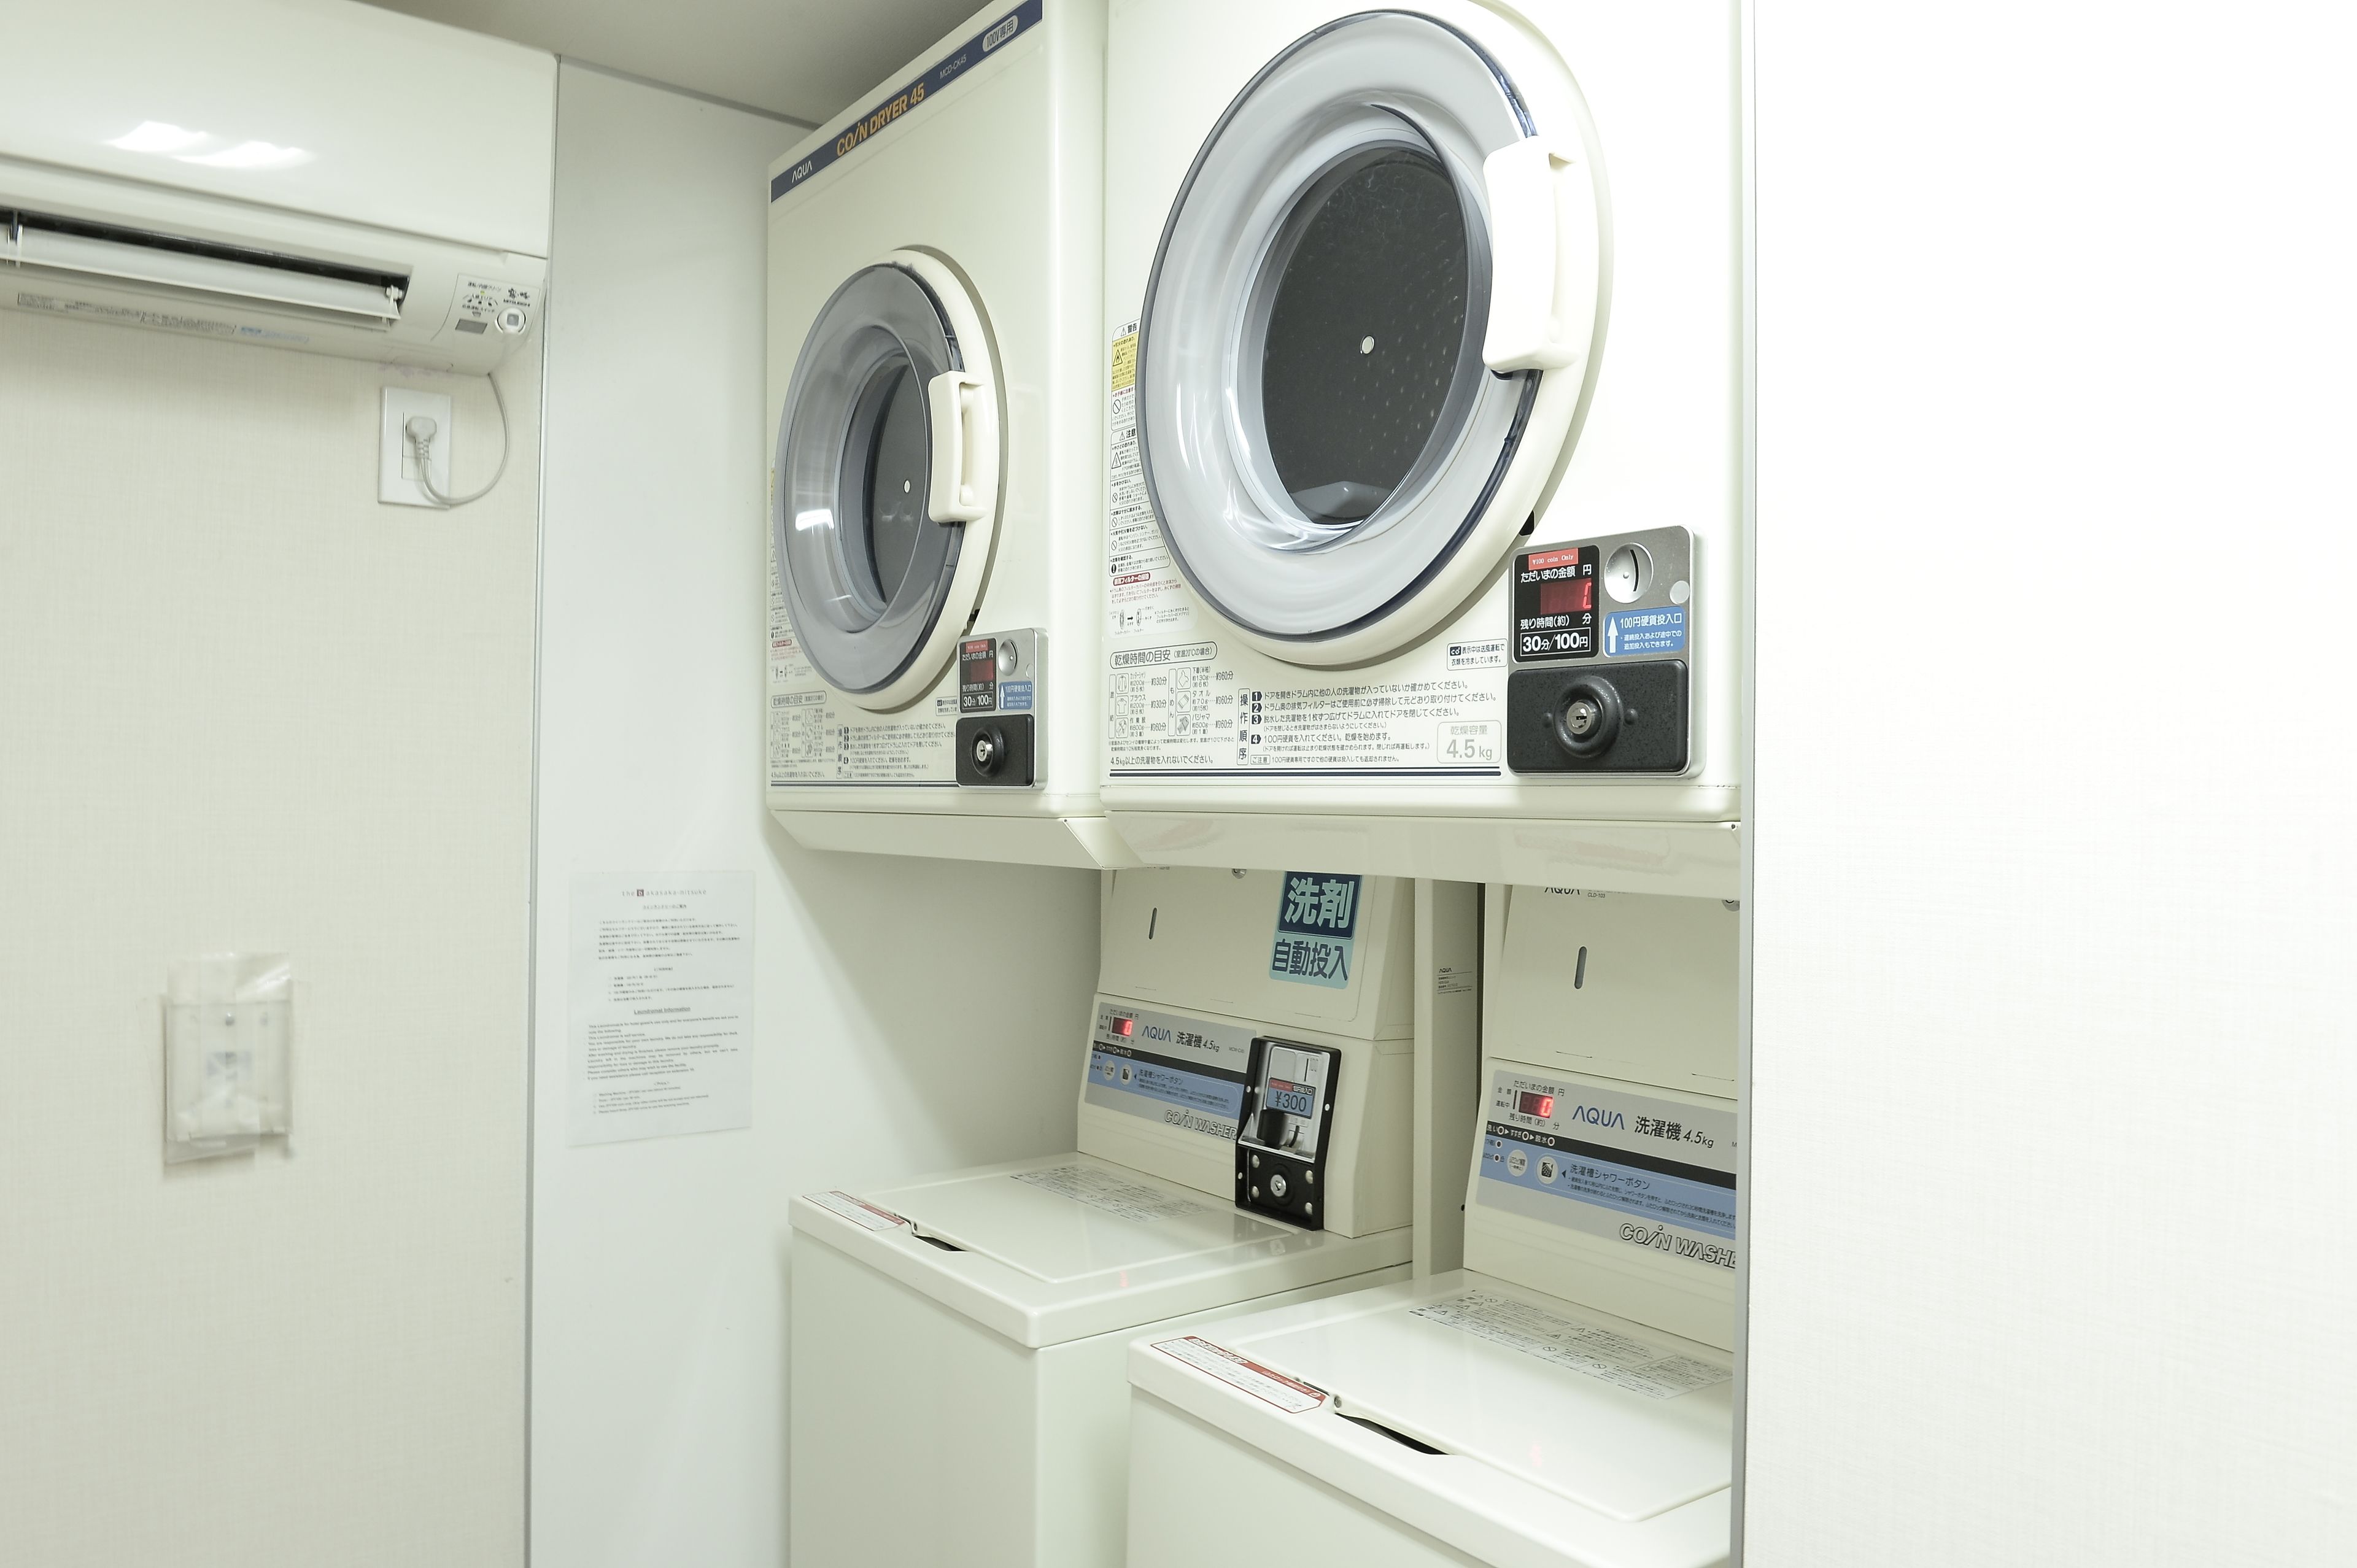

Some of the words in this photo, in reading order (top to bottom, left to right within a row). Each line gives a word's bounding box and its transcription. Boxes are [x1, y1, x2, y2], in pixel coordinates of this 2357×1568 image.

[986, 19, 1014, 48] 100V専用
[940, 54, 967, 79] MCD-CK45
[792, 160, 813, 183] AQUA
[870, 95, 908, 135] DRYER
[910, 82, 925, 105] 45
[1562, 553, 1574, 562] Only
[1520, 565, 1576, 584] ただいまの金額
[1582, 564, 1593, 576] 円
[1520, 616, 1570, 629] 残り時間(約)
[1582, 613, 1592, 625] 分
[1522, 632, 1589, 652] 30分/100円
[1114, 649, 1171, 666] 乾燥時間の目安
[1450, 725, 1488, 736] 乾燥容量
[1447, 739, 1475, 759] 4.5
[1479, 746, 1493, 761] kg
[1284, 877, 1355, 929] 洗剤
[1271, 938, 1348, 981] 自動投入
[1142, 1025, 1172, 1042] AQUA
[1176, 1031, 1203, 1049] 洗濯機
[1202, 1038, 1220, 1053] 4.5kg
[1514, 1080, 1555, 1094] ただいまの金額
[1558, 1088, 1565, 1097] 円
[1275, 1091, 1307, 1113] ¥300
[1541, 1098, 1554, 1118] 0
[1552, 1122, 1560, 1130] 分
[1572, 1105, 1625, 1130] AQUA
[1635, 1115, 1682, 1141] 洗濯機
[1682, 1129, 1714, 1149] 4.5kg
[1570, 1164, 1651, 1190] 洗濯槽シャワーボタン
